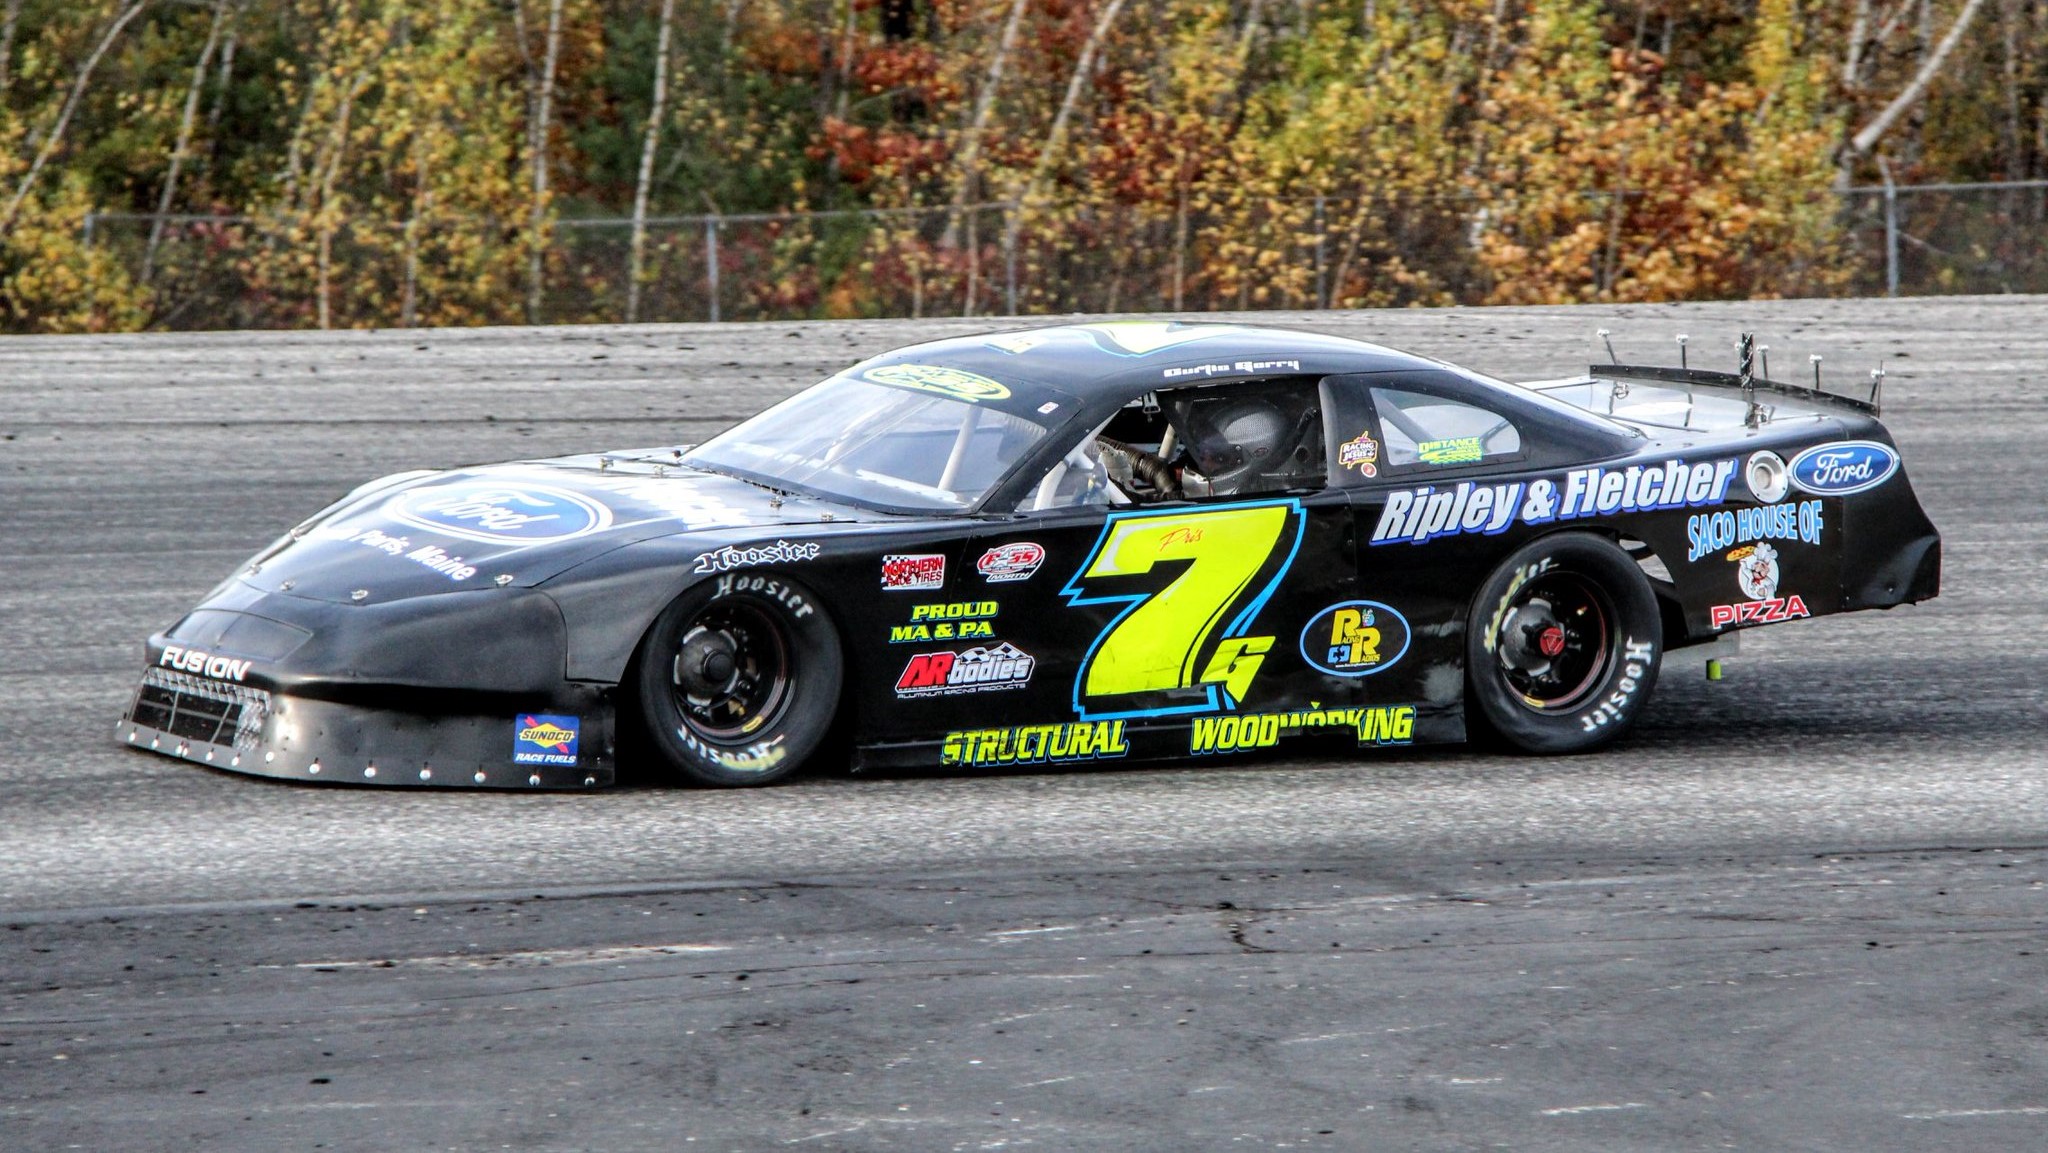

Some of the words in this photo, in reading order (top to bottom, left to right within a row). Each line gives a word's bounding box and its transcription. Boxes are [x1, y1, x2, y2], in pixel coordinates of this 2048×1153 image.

[1812, 450, 1873, 486] Ford
[416, 489, 561, 531] Ford
[1370, 481, 1522, 544] Ripley
[1522, 478, 1557, 523] &
[1560, 459, 1737, 516] Fletcher
[1687, 510, 1736, 562] SACO
[1737, 502, 1798, 543] HOUSE
[1798, 499, 1824, 545] OF
[405, 545, 477, 581] Maine
[693, 540, 821, 574] Hoosier
[883, 556, 944, 576] NORTHERN
[914, 570, 943, 583] TIRES
[989, 571, 1031, 581] NORTH
[709, 572, 814, 618] Hoosier
[911, 601, 999, 621] PROUD
[1711, 595, 1811, 629] PIZZA
[890, 625, 931, 642] MA
[934, 623, 954, 639] &
[958, 621, 994, 638] PA
[160, 646, 252, 681] FUSION
[897, 691, 943, 699] ALUMINUM
[944, 688, 977, 696] RACING
[978, 683, 1026, 692] PRODUCTS
[1580, 635, 1653, 732] Hoosier
[522, 730, 572, 741] SUNOCO
[942, 720, 1128, 767] STRUCTURAL
[515, 753, 545, 763] RACE
[544, 754, 577, 764] FUELS
